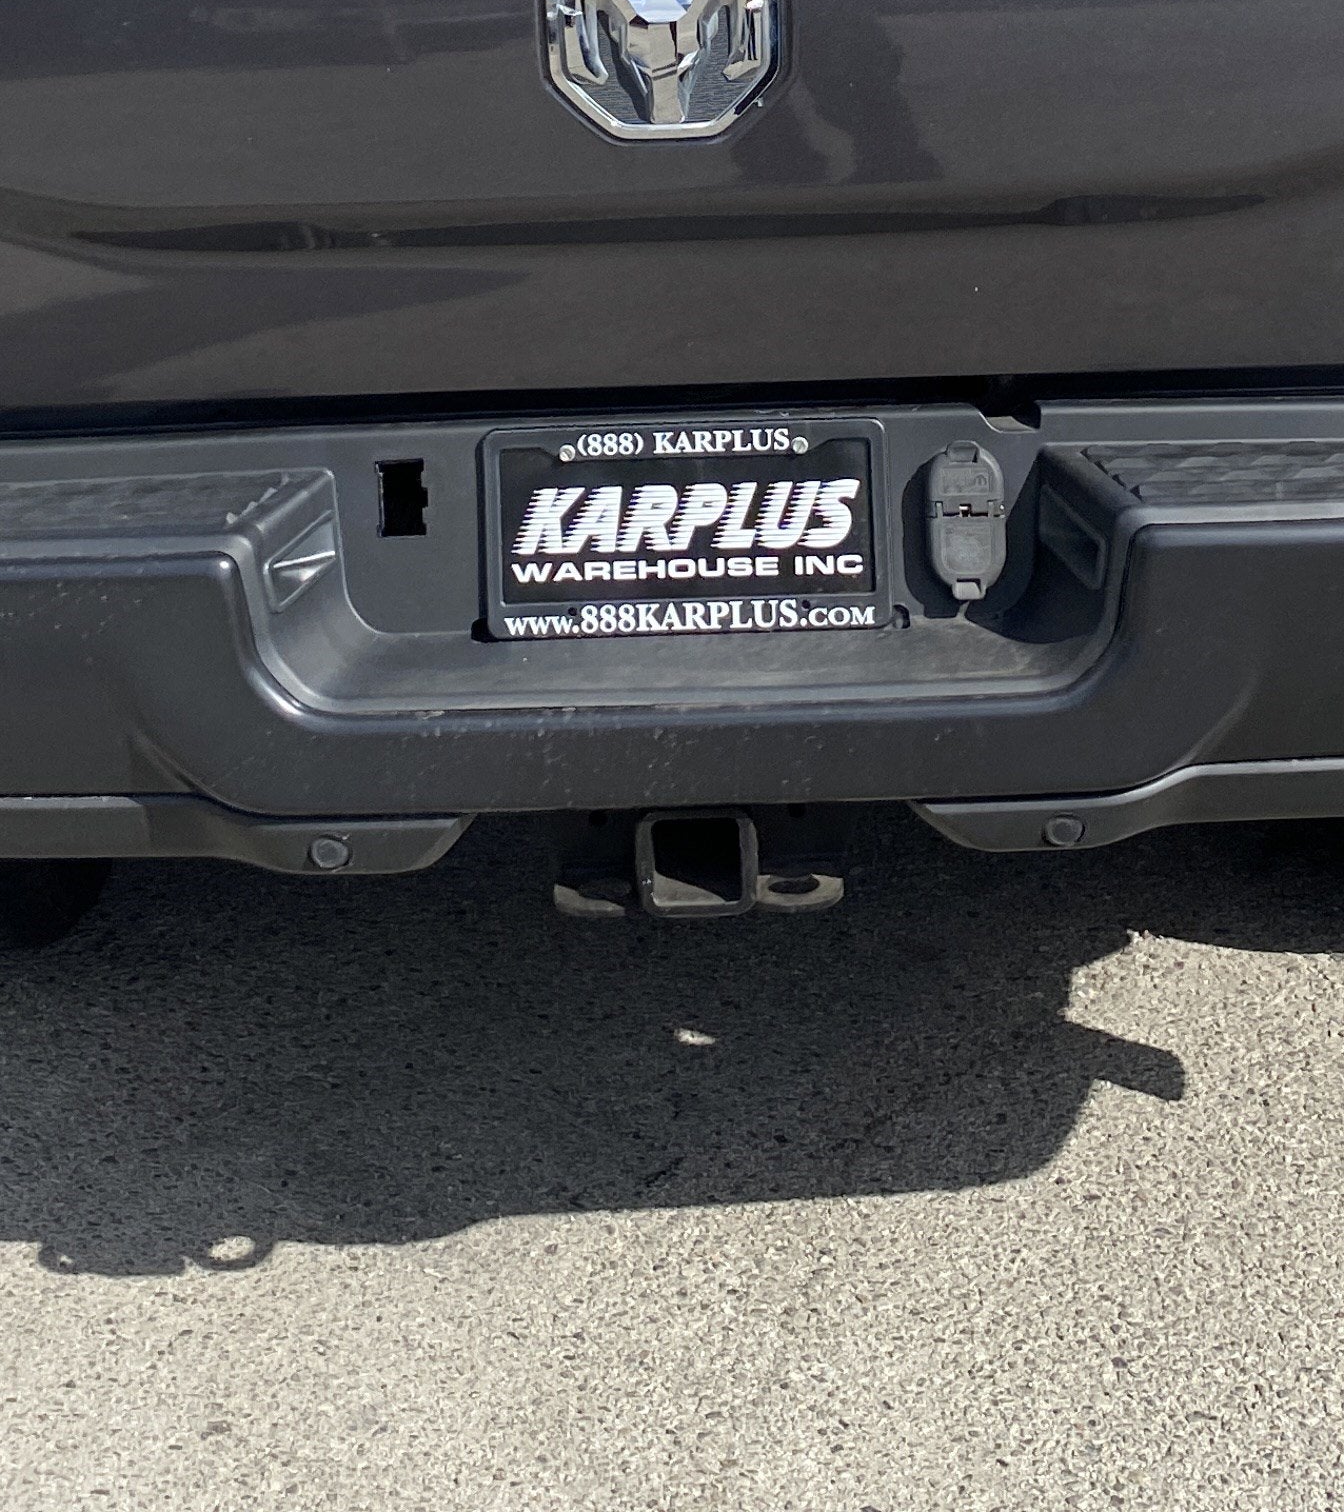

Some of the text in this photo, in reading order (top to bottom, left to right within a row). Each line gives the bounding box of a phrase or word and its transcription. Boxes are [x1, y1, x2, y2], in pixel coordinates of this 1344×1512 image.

[575, 428, 790, 457] (888) KARPLUS
[510, 478, 861, 556] KARPLUS
[511, 554, 864, 583] WAREHOUSE INC
